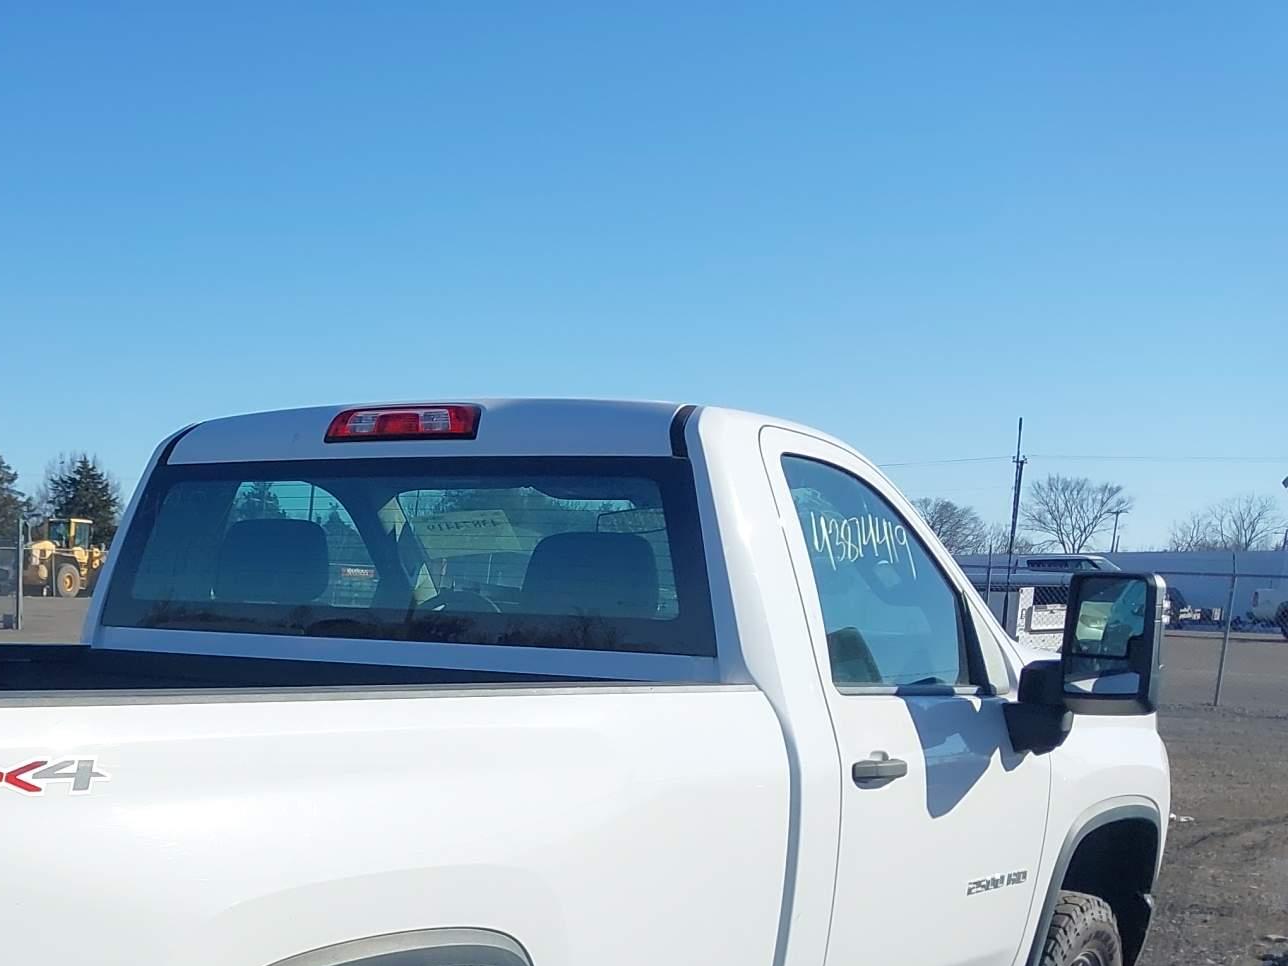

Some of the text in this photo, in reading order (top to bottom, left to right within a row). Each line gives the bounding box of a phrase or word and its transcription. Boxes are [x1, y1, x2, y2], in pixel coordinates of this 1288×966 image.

[809, 511, 917, 581] 43874419
[966, 869, 1029, 897] 2500 HD
